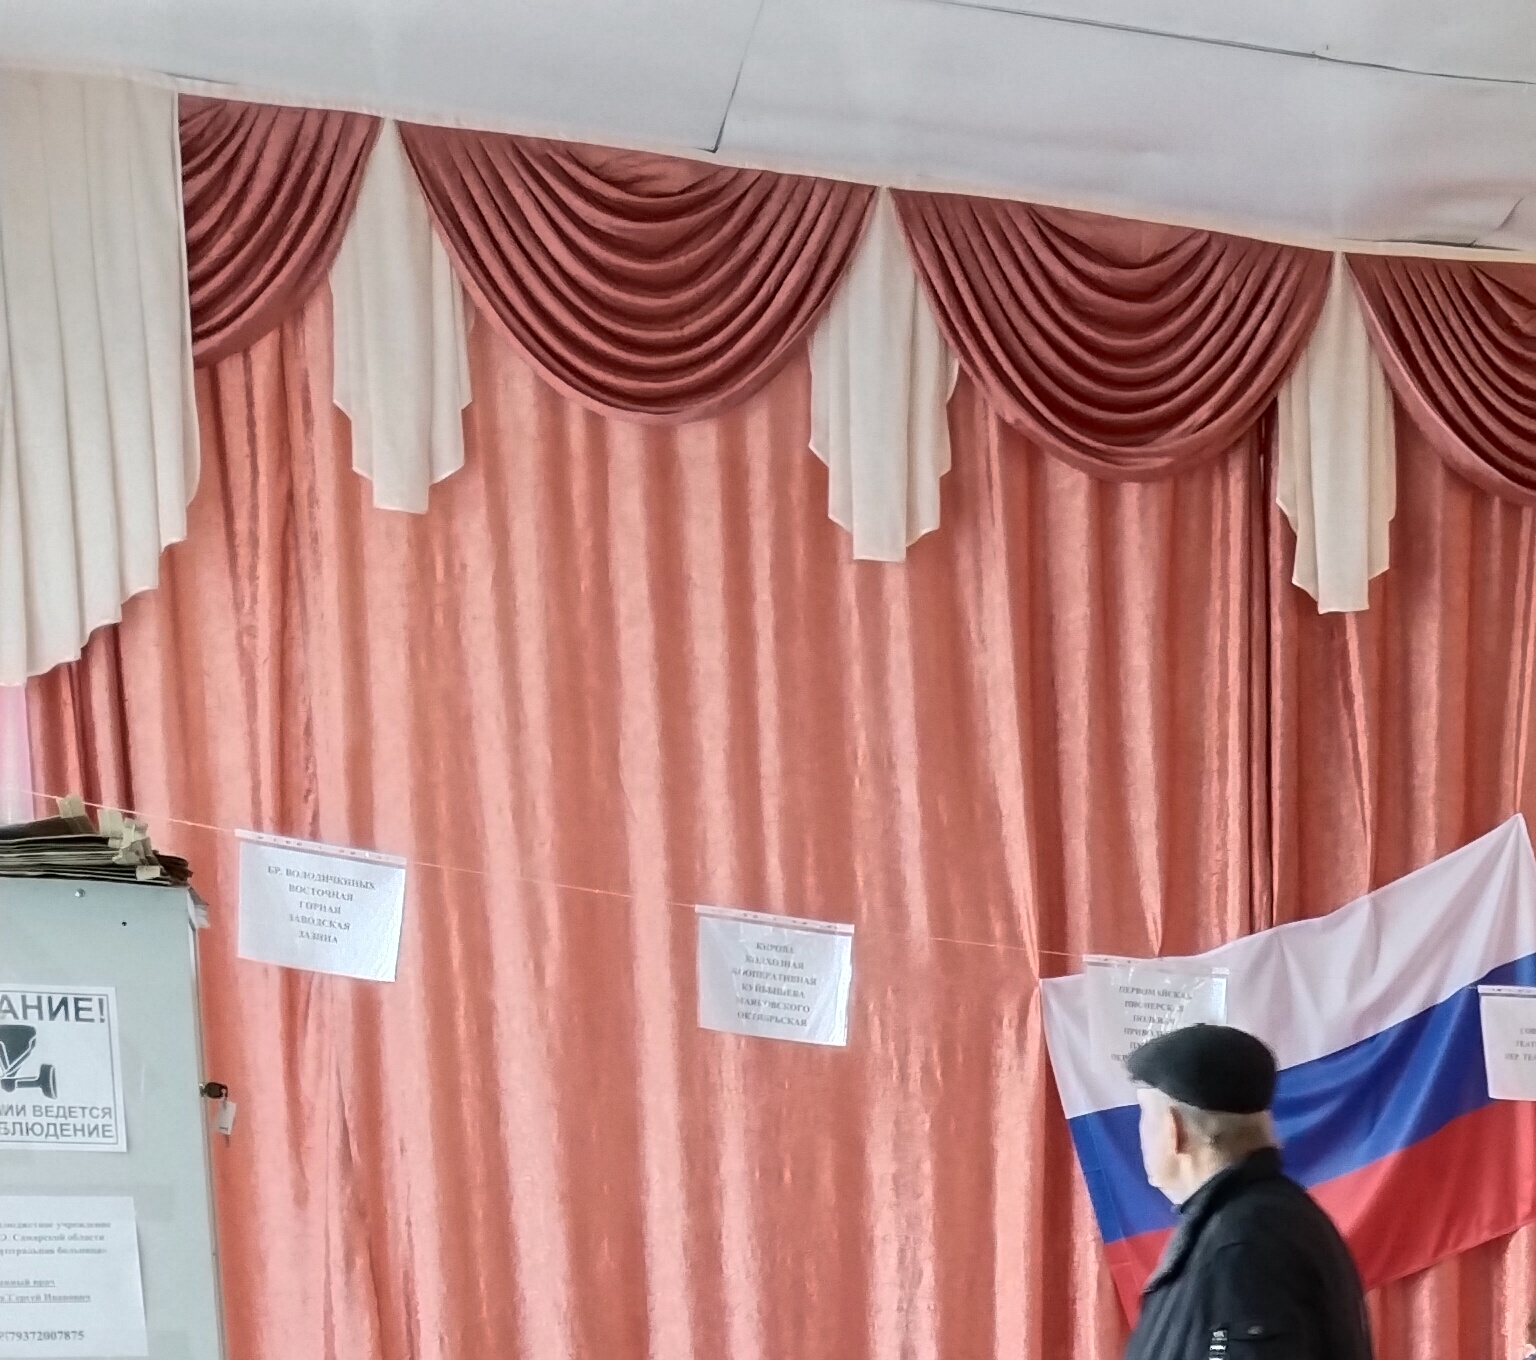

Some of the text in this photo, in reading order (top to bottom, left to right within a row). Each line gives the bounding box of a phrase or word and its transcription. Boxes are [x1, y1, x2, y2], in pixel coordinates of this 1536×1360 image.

[288, 884, 354, 902] ВОСТОЧНАЯ
[299, 901, 342, 914] ГОРНАЯ
[32, 1105, 112, 1120] ВЕДЕТСЯ
